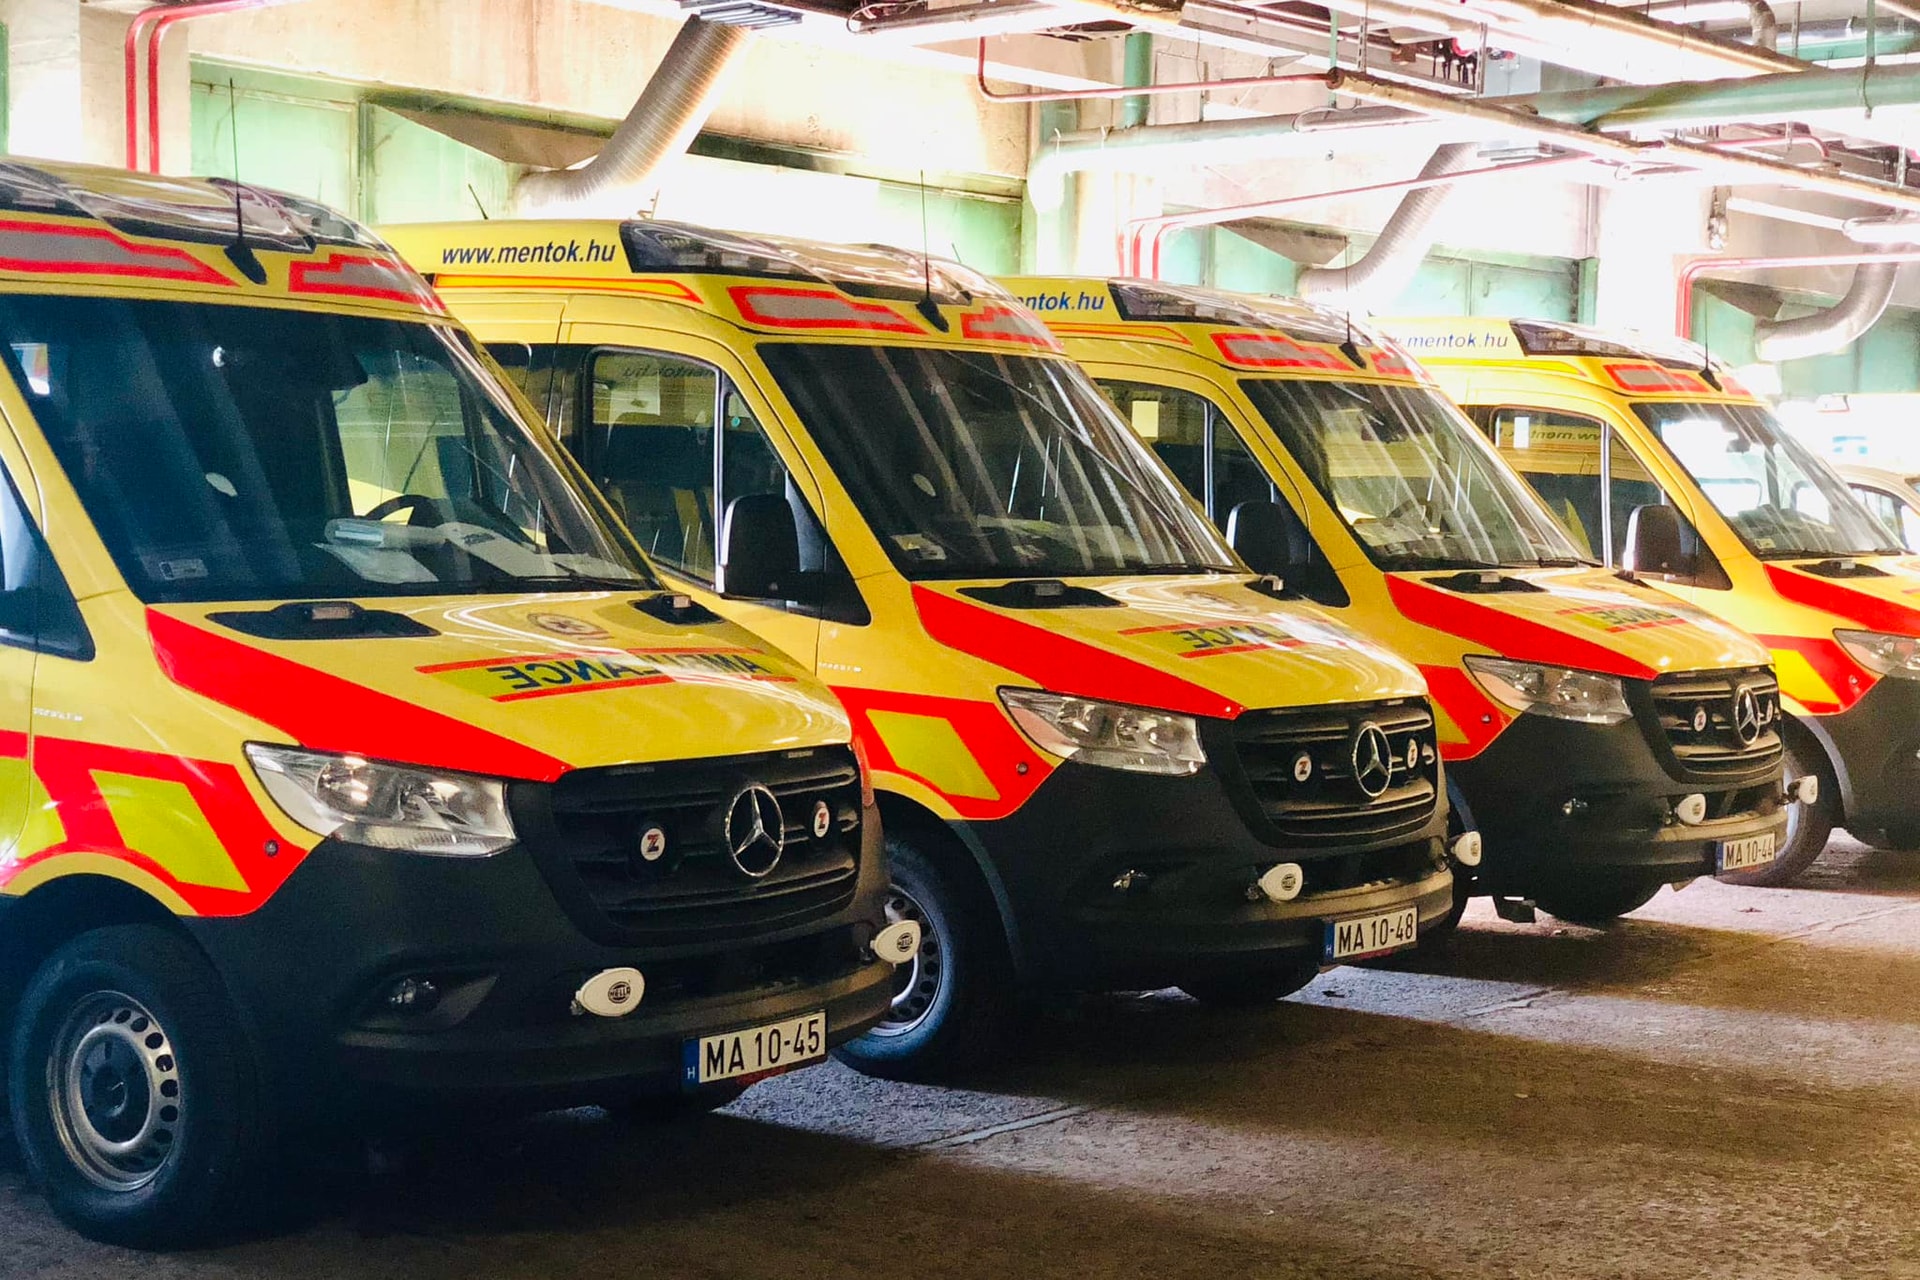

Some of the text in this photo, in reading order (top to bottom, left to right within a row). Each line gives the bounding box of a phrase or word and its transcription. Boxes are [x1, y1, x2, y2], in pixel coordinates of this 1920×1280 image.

[442, 239, 616, 265] www.mentok.hu
[646, 833, 659, 853] Z
[1726, 837, 1773, 868] MA 10-44
[1338, 923, 1365, 954] MA
[1371, 912, 1414, 946] 10-48
[686, 1018, 821, 1080] H MA 10-45
